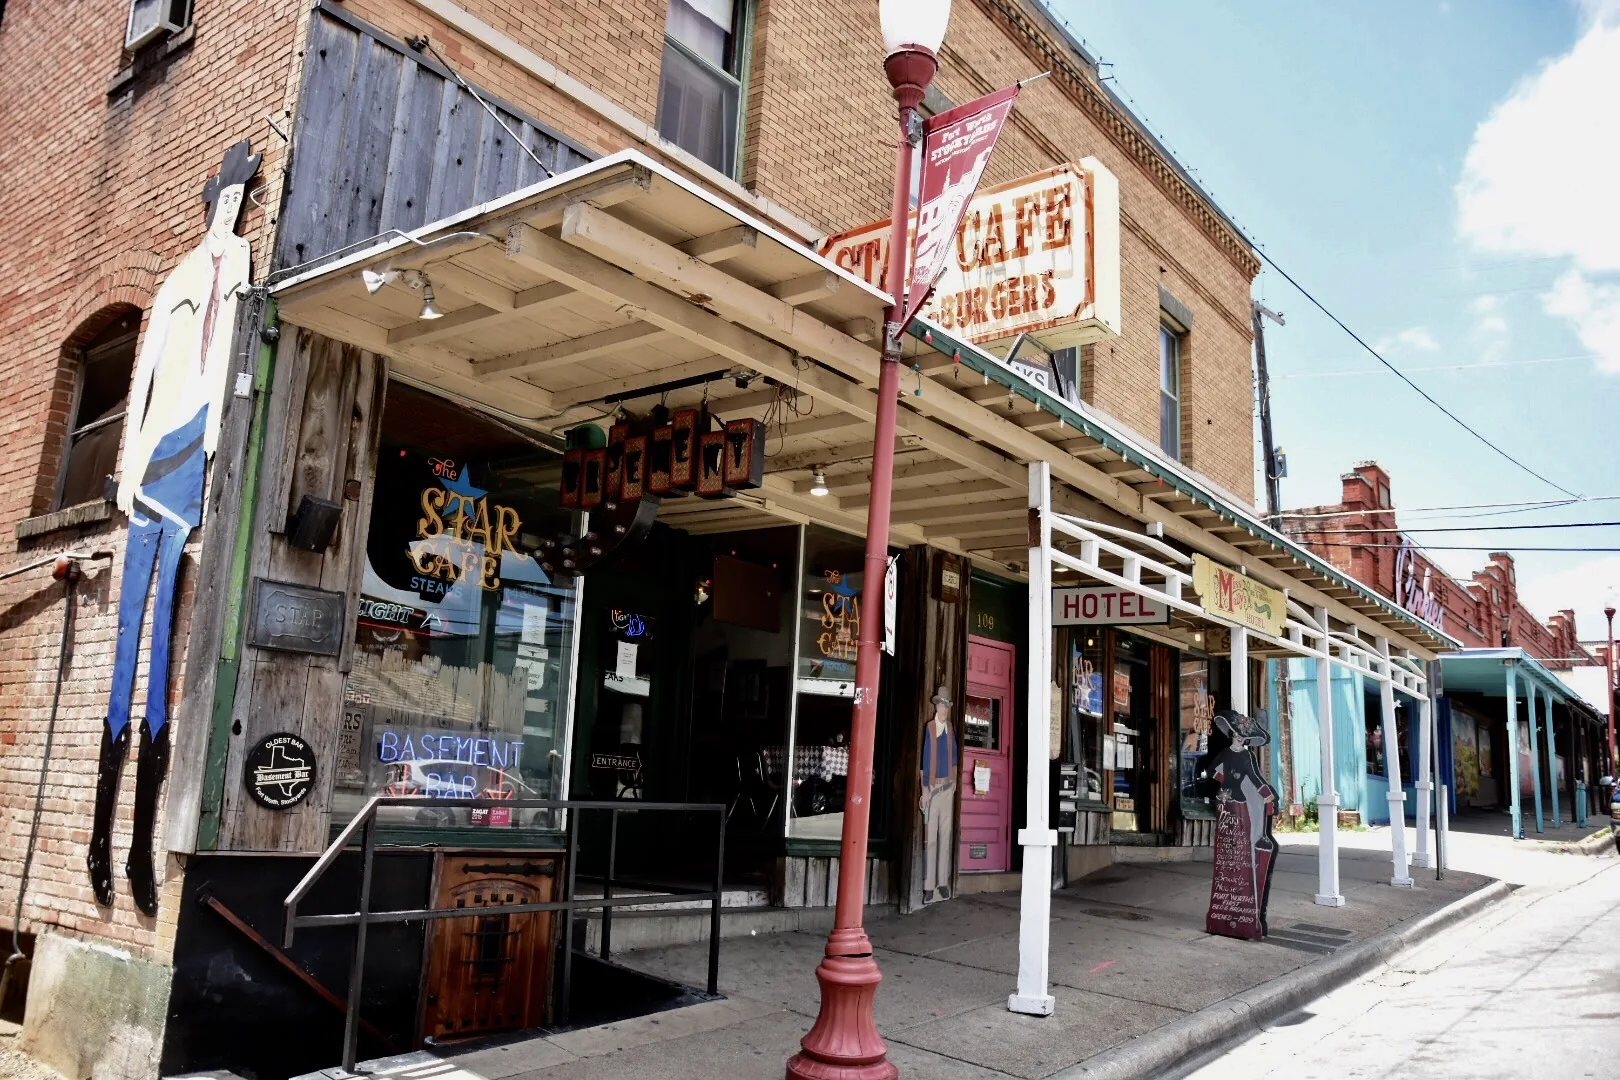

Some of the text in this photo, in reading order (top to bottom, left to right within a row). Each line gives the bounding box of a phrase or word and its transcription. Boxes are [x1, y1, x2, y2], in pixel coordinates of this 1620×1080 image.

[930, 119, 998, 162] STOCKYARDS
[941, 113, 993, 144] Fort Worth
[955, 182, 1073, 273] CAFE
[427, 457, 457, 481] The
[416, 487, 528, 562] STAR
[405, 541, 500, 592] CAFE
[410, 576, 463, 597] STEAKS
[1063, 592, 1156, 619] HOTEL
[976, 613, 994, 630] 109
[265, 737, 304, 751] OLDEST BAR
[379, 731, 525, 768] BASEMENT
[596, 757, 637, 768] ENTRANCE
[256, 770, 310, 782] Basement Bar
[425, 773, 478, 800] BAR
[254, 786, 265, 798] Fort
[1212, 892, 1230, 900] FORT
